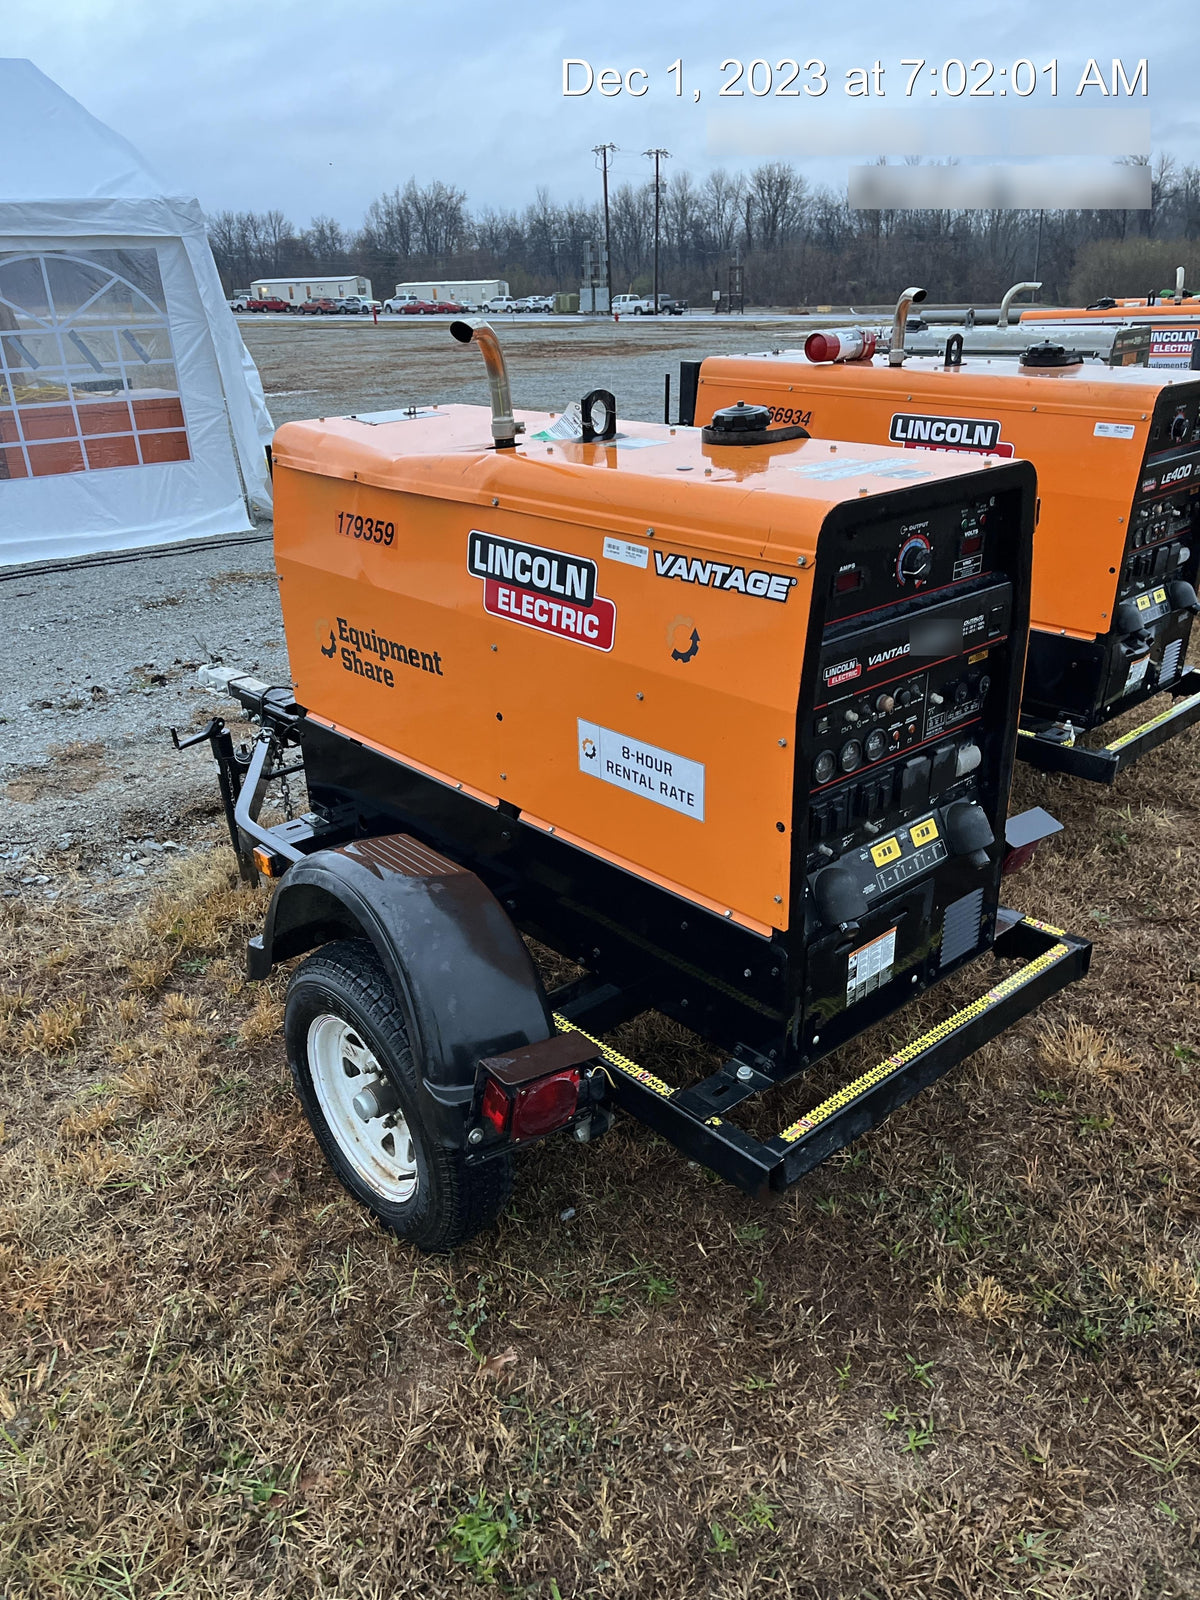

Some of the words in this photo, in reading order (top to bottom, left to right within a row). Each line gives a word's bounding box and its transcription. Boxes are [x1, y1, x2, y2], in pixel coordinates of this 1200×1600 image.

[1150, 331, 1196, 343] INCOLN
[1153, 344, 1192, 353] ELECTRI
[767, 405, 812, 426] 66934
[895, 418, 993, 446] LINCOLN
[1161, 463, 1192, 485] LE400
[337, 511, 395, 546] 179359
[909, 521, 929, 531] OUTPUT
[474, 539, 588, 601] LINCOLN
[839, 562, 856, 573] AMPS
[497, 586, 600, 640] ELECTRIC
[336, 616, 444, 677] Equipment
[867, 643, 911, 666] VANTAG
[340, 646, 395, 689] Share
[825, 660, 856, 679] LINCOLN
[621, 745, 673, 777] 8-HOUR
[606, 759, 655, 791] RENTAL
[659, 781, 695, 807] RATE
[810, 1110, 825, 1121] DO
[824, 1098, 843, 1111] NOT
[842, 1077, 871, 1098] STAND
[871, 1063, 893, 1080] HERE
